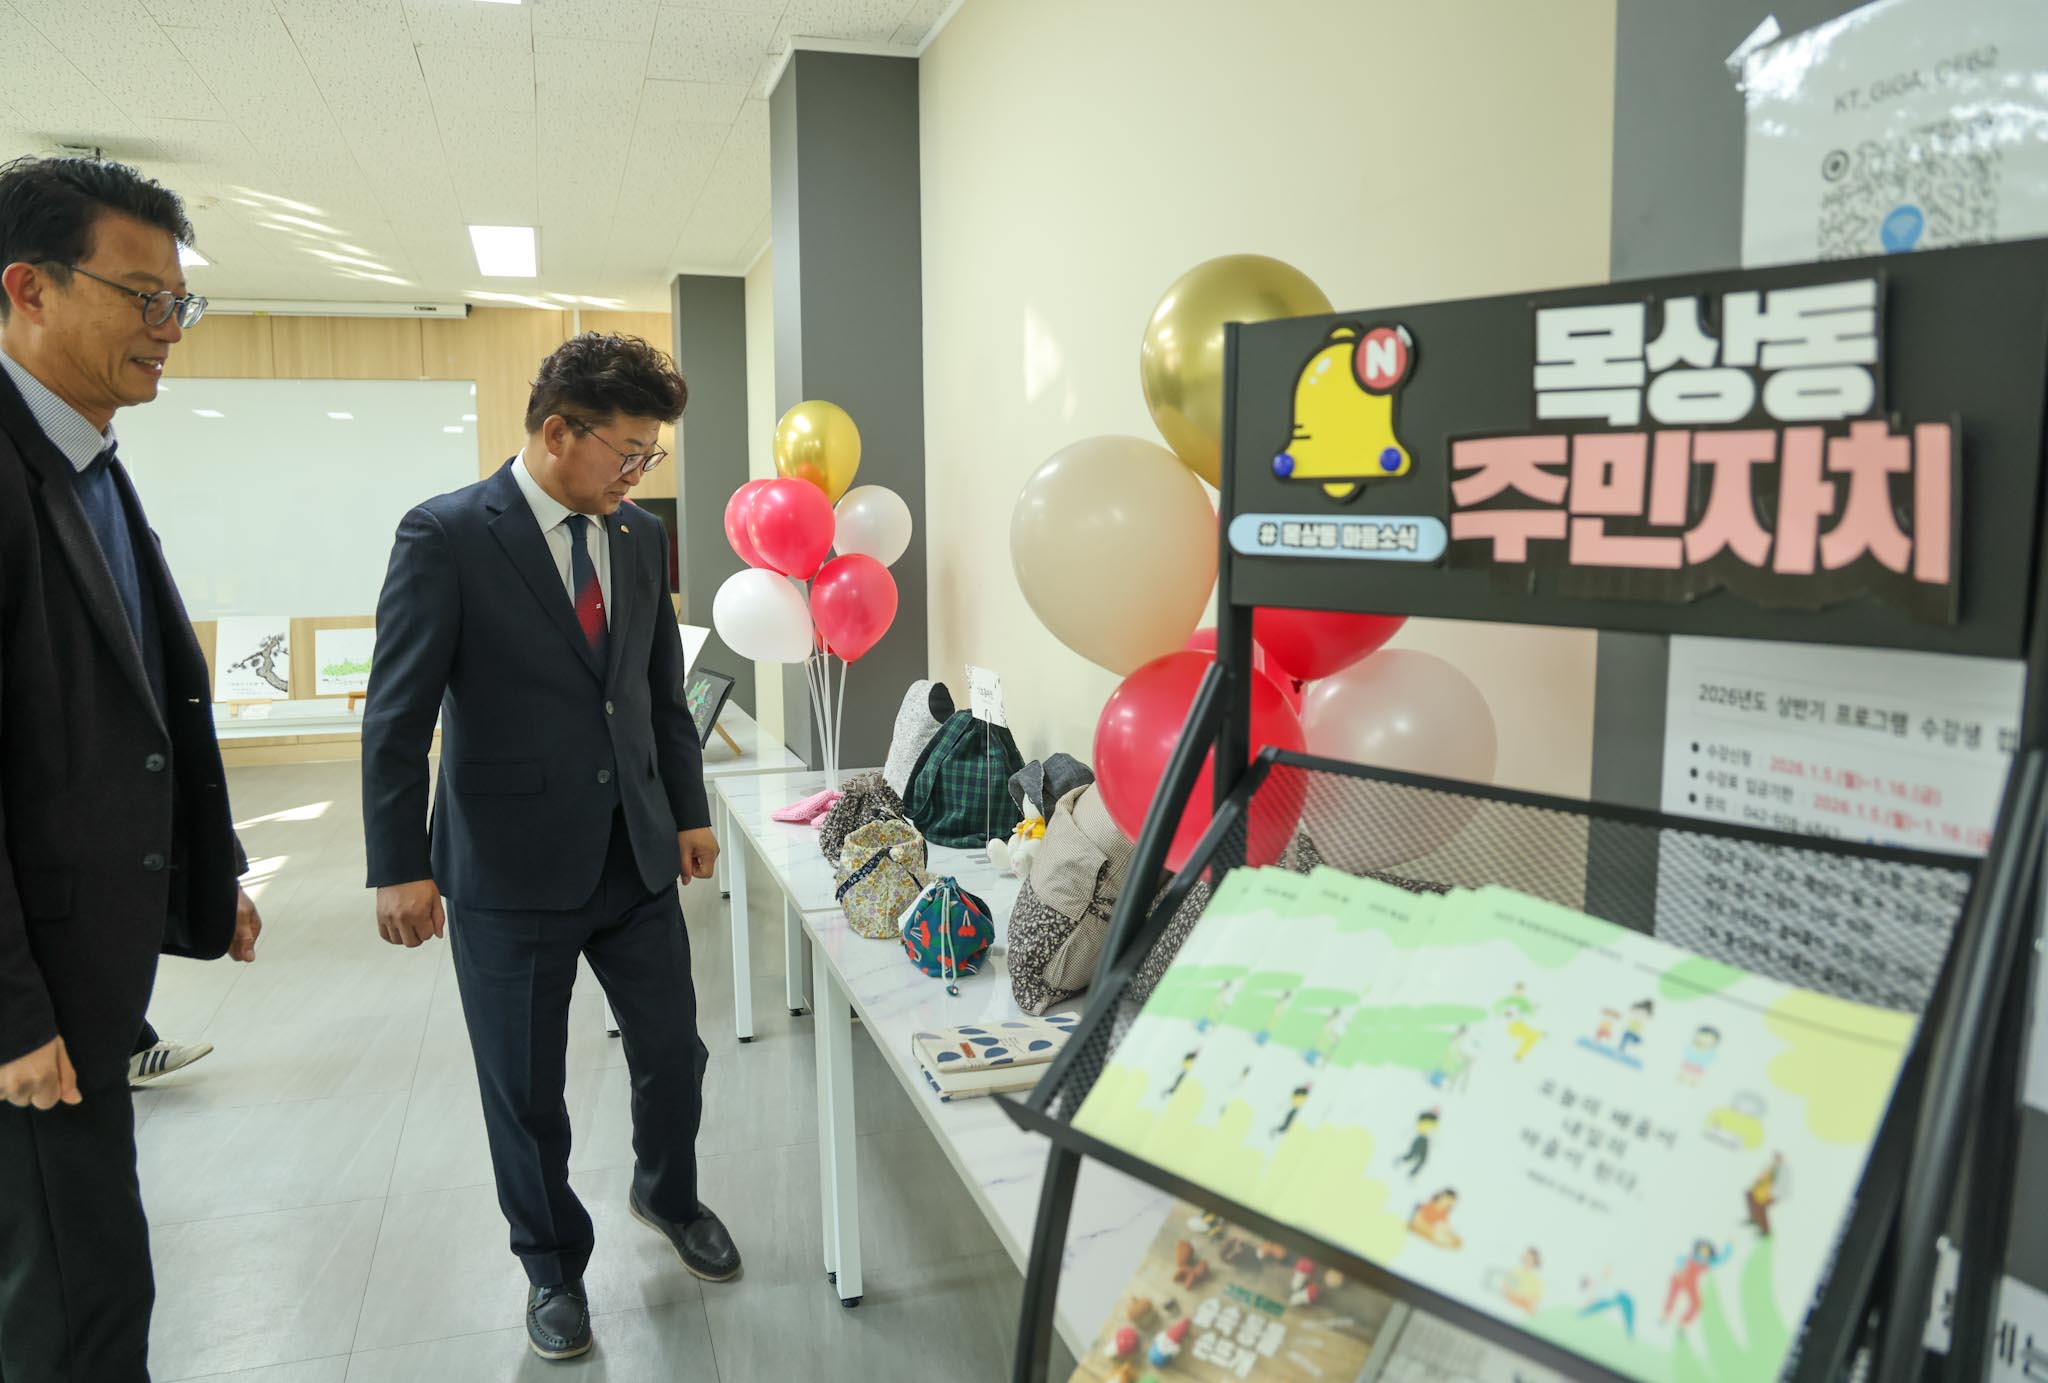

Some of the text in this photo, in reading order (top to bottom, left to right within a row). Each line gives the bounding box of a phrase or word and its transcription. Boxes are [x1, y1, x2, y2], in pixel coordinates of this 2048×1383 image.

[1366, 336, 1396, 380] N
[1534, 278, 1879, 426] 목상동
[1258, 521, 1278, 546] #
[1450, 420, 1952, 585] 주민자치
[1699, 682, 1768, 713] 2026년도
[1777, 694, 1826, 725] 상반기
[1835, 702, 1909, 739] 프로그램
[1919, 716, 1981, 752] 수강생
